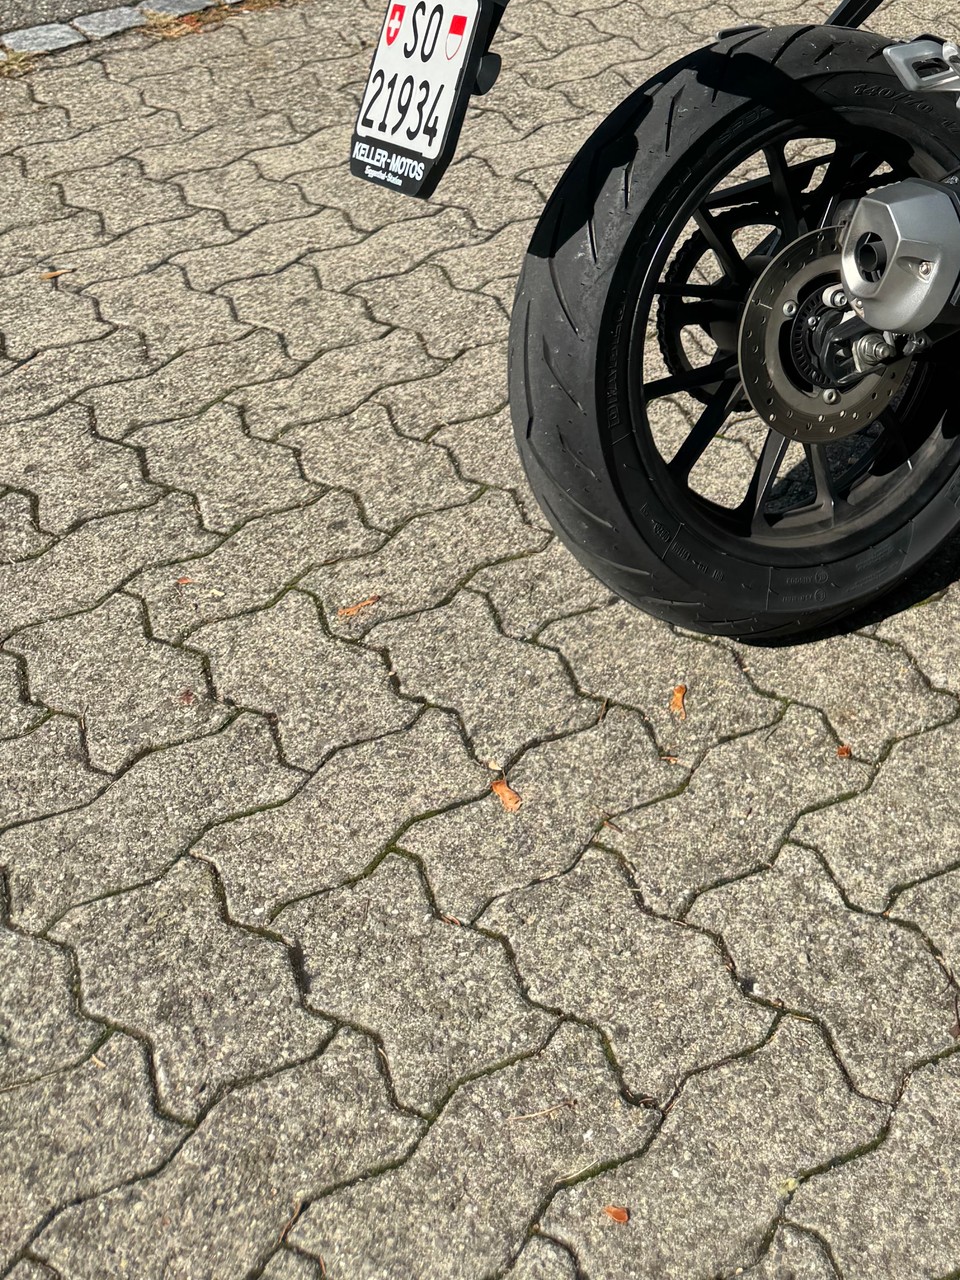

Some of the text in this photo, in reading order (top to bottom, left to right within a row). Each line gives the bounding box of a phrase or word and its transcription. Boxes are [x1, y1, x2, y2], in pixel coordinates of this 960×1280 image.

[403, 0, 444, 63] SO
[361, 69, 445, 147] 21934
[352, 141, 425, 181] KELLER-MOTOS
